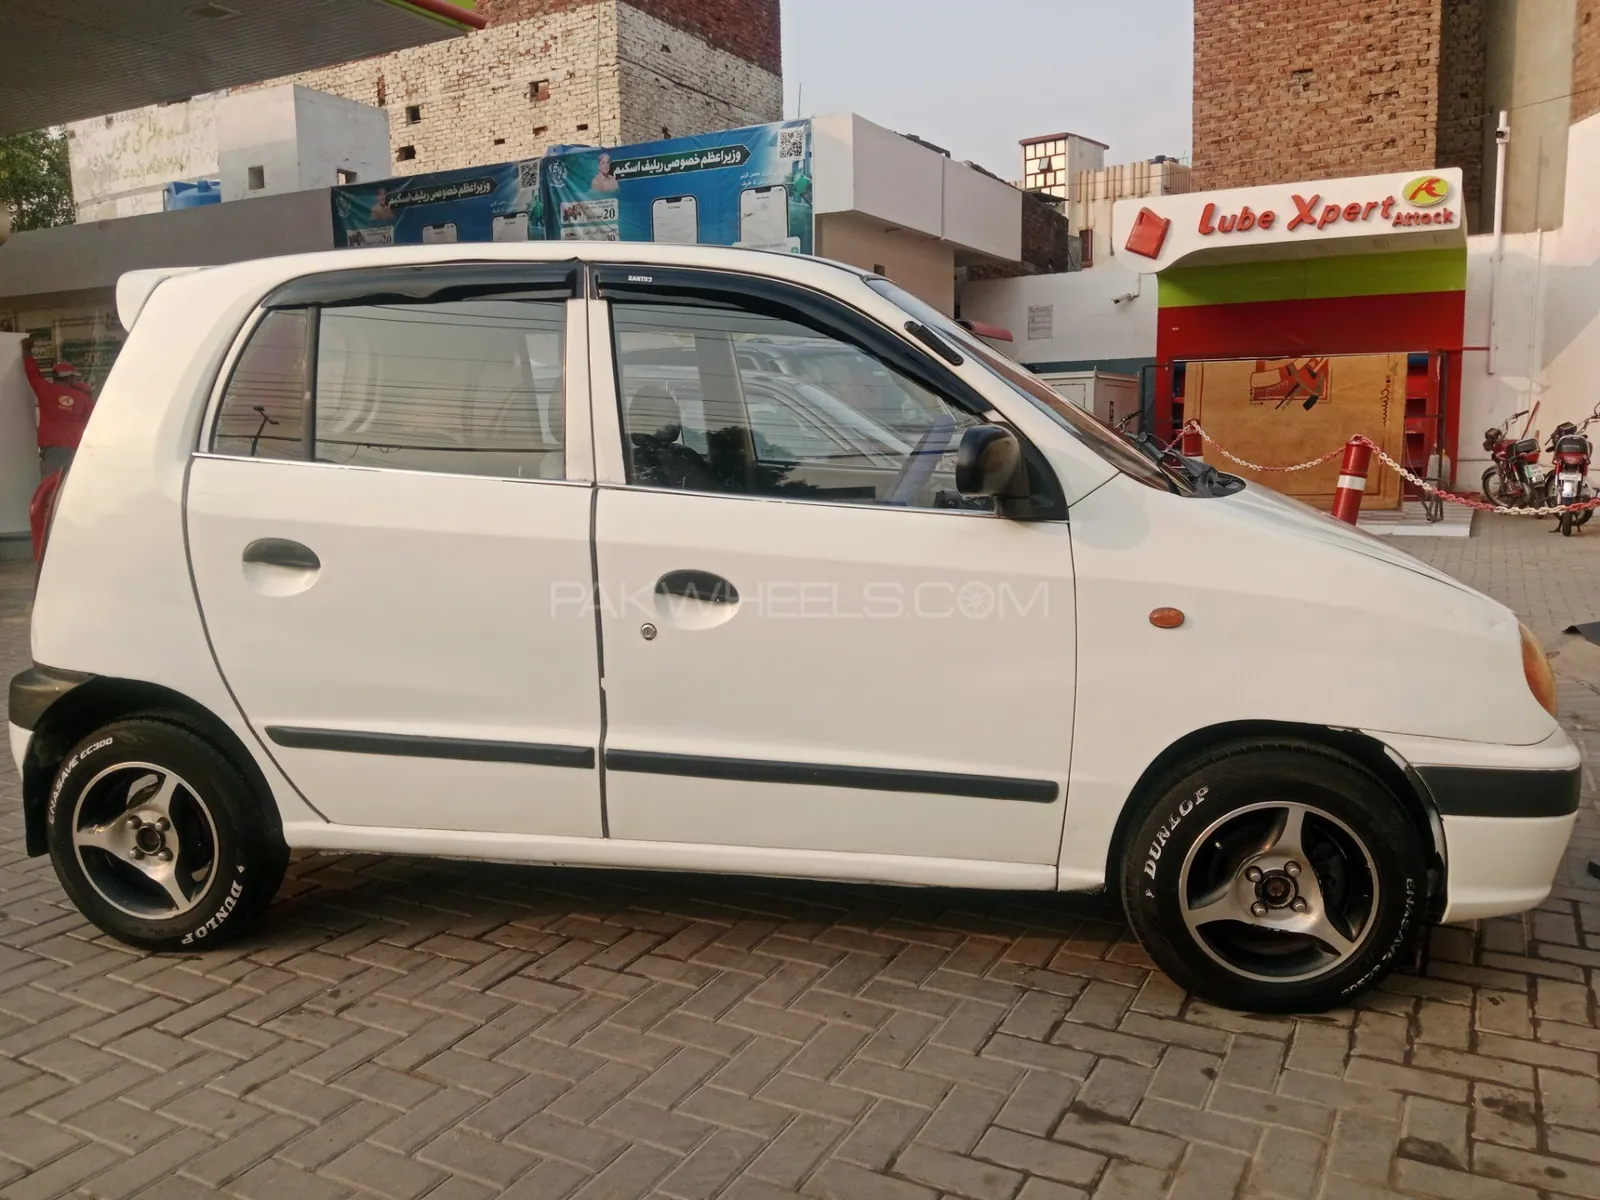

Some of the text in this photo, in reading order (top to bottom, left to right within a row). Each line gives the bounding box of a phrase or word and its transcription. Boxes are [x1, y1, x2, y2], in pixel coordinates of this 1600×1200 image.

[613, 161, 641, 178] اسکیم
[641, 159, 664, 174] ریلیف
[664, 154, 701, 171] خصوصی
[430, 185, 458, 200] خصوصی
[602, 208, 616, 219] 20
[1198, 193, 1396, 236] Lube Xpert
[1392, 207, 1454, 227] Attock
[80, 737, 114, 760] EC300
[1143, 785, 1210, 880] DUNLOP
[181, 880, 243, 946] DUNLOP
